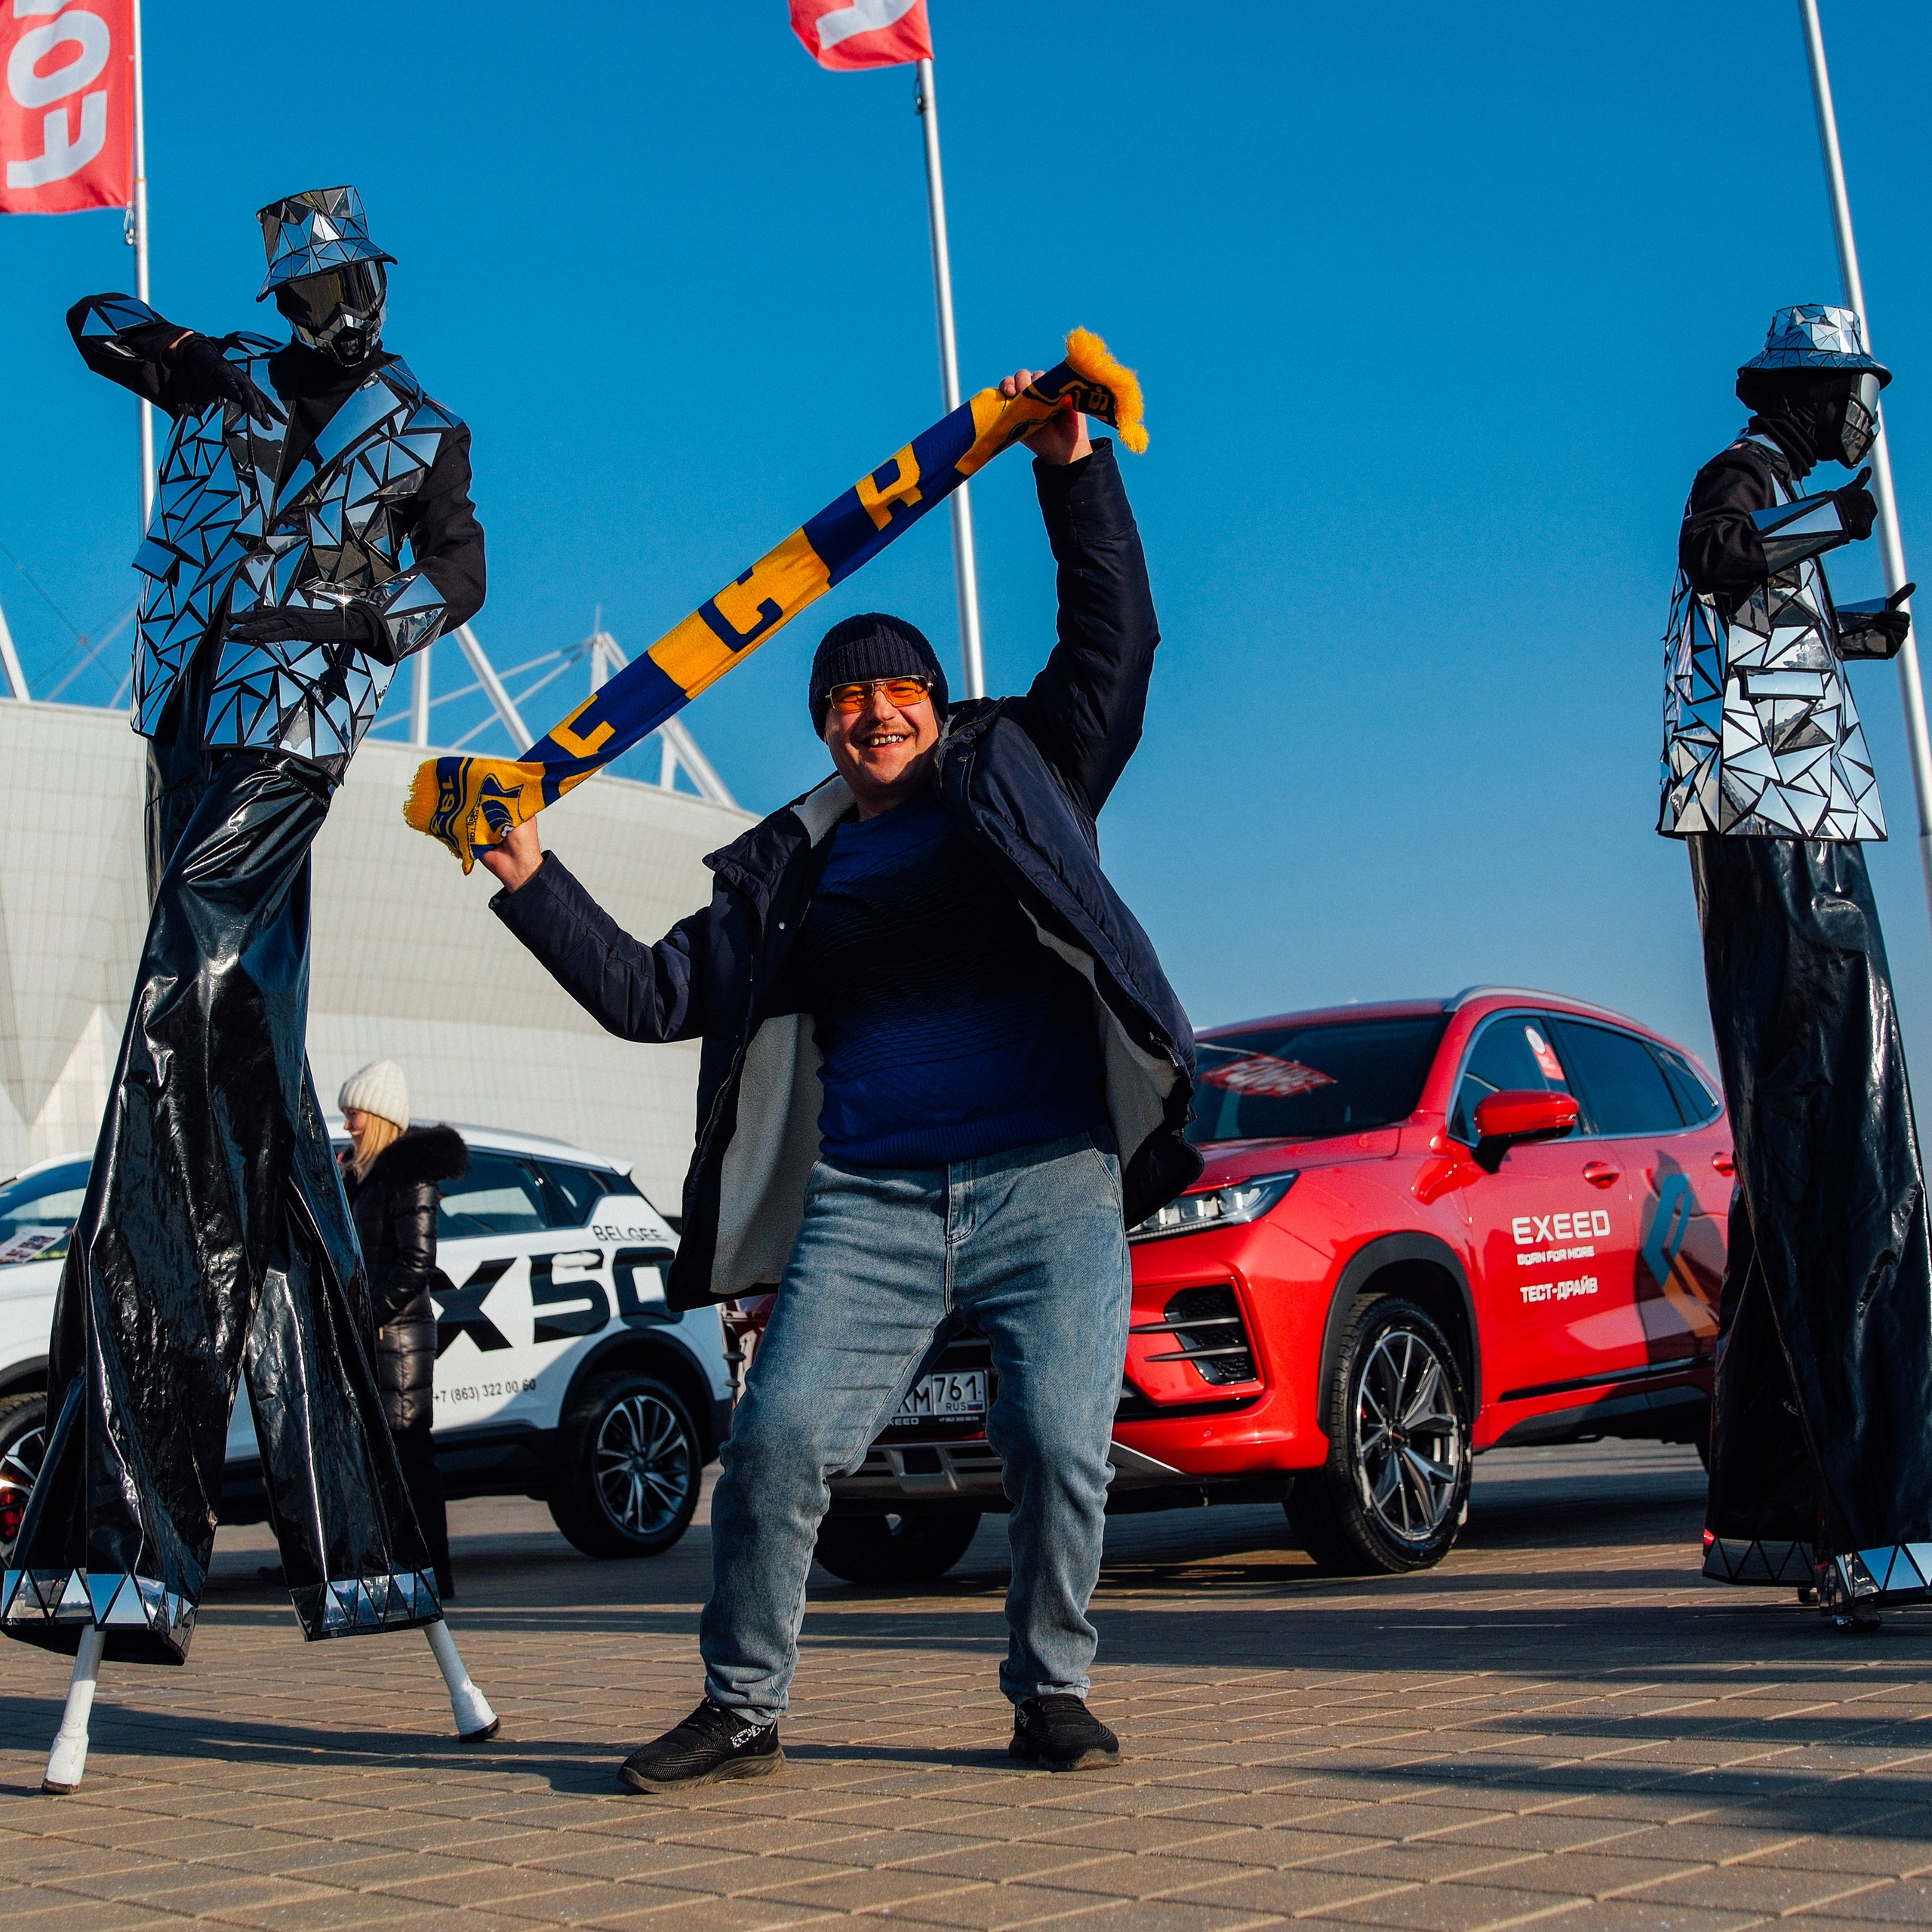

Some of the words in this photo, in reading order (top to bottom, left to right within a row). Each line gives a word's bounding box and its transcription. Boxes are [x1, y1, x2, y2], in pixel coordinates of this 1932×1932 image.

[469, 810, 480, 844] РОСТОВ
[592, 1226, 668, 1241] BELGEE
[1512, 1210, 1611, 1245] EXEED
[1517, 1251, 1546, 1266] BORN
[1546, 1249, 1567, 1263] FOR
[1567, 1246, 1595, 1259] MORE
[1520, 1275, 1598, 1303] ТЕСТ-ДРАЙВ
[451, 1386, 480, 1404] (863)
[481, 1383, 502, 1397] 322
[505, 1380, 518, 1393] 00
[934, 1375, 977, 1402] 761
[946, 1402, 967, 1411] RUS
